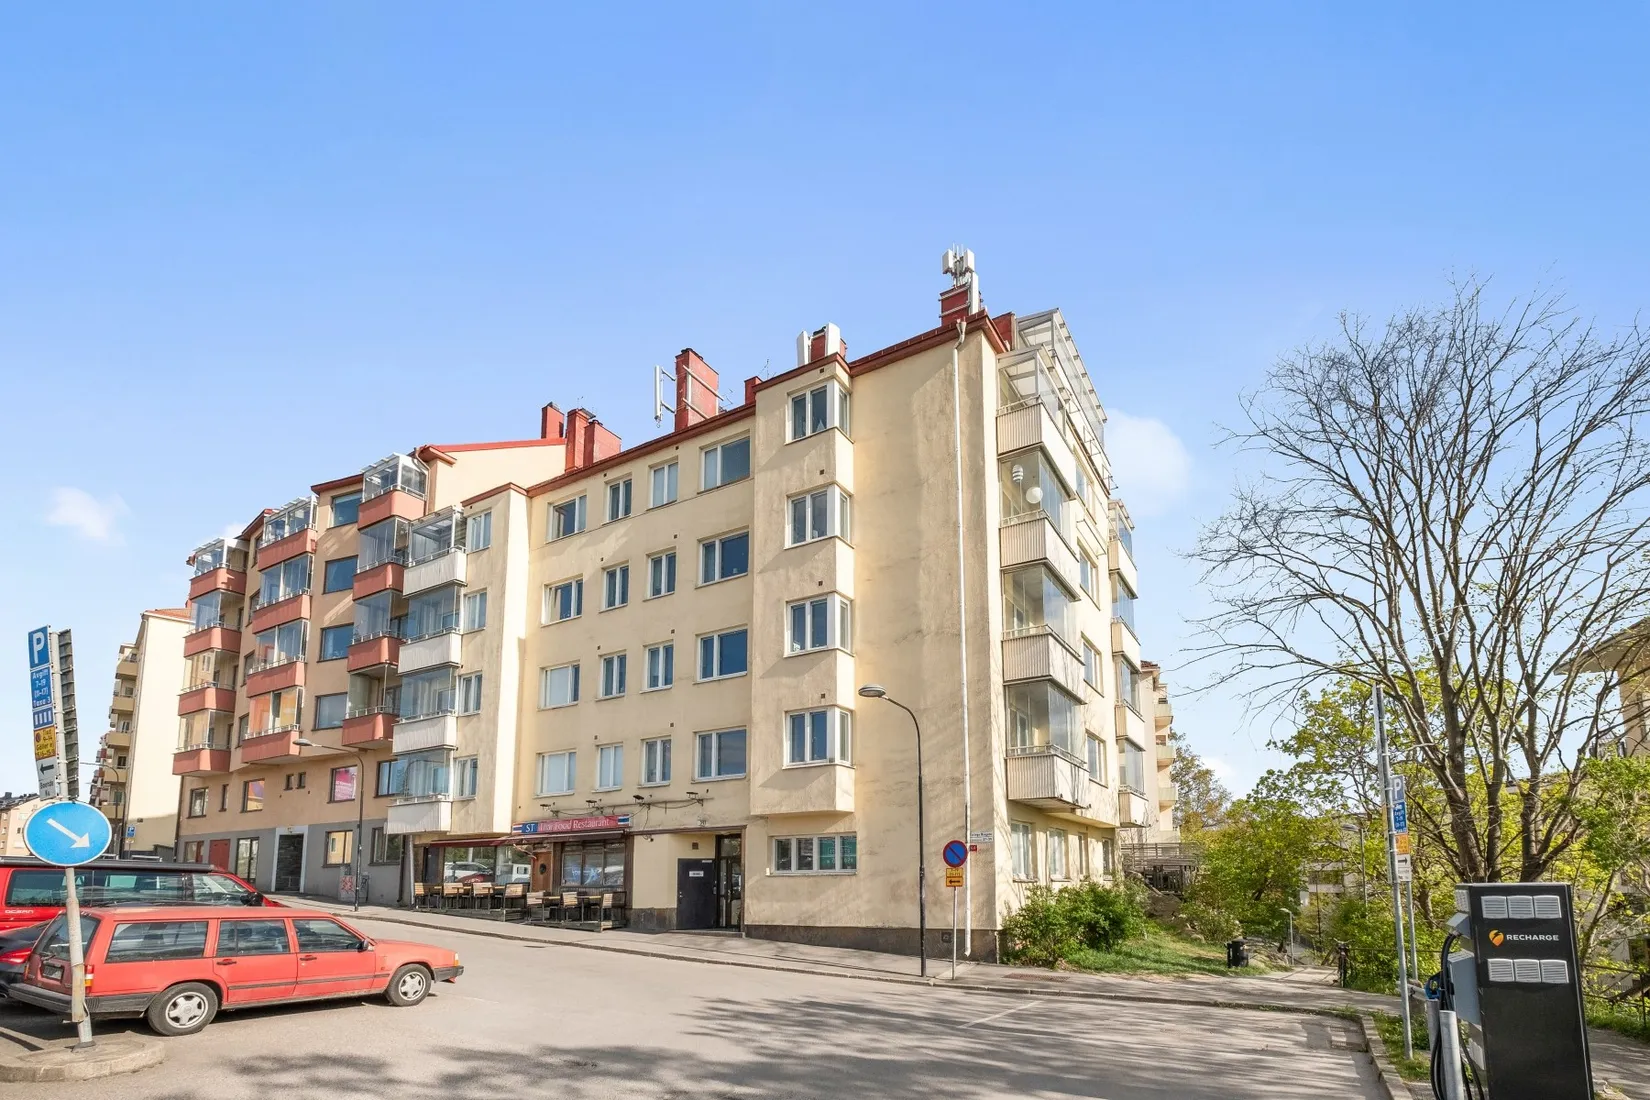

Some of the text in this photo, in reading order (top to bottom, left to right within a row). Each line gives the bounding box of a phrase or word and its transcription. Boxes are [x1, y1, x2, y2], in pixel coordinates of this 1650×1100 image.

[32, 631, 45, 664] P
[1394, 778, 1402, 799] P
[525, 823, 535, 832] ST
[554, 820, 571, 830] Food
[573, 818, 610, 829] Restaurant
